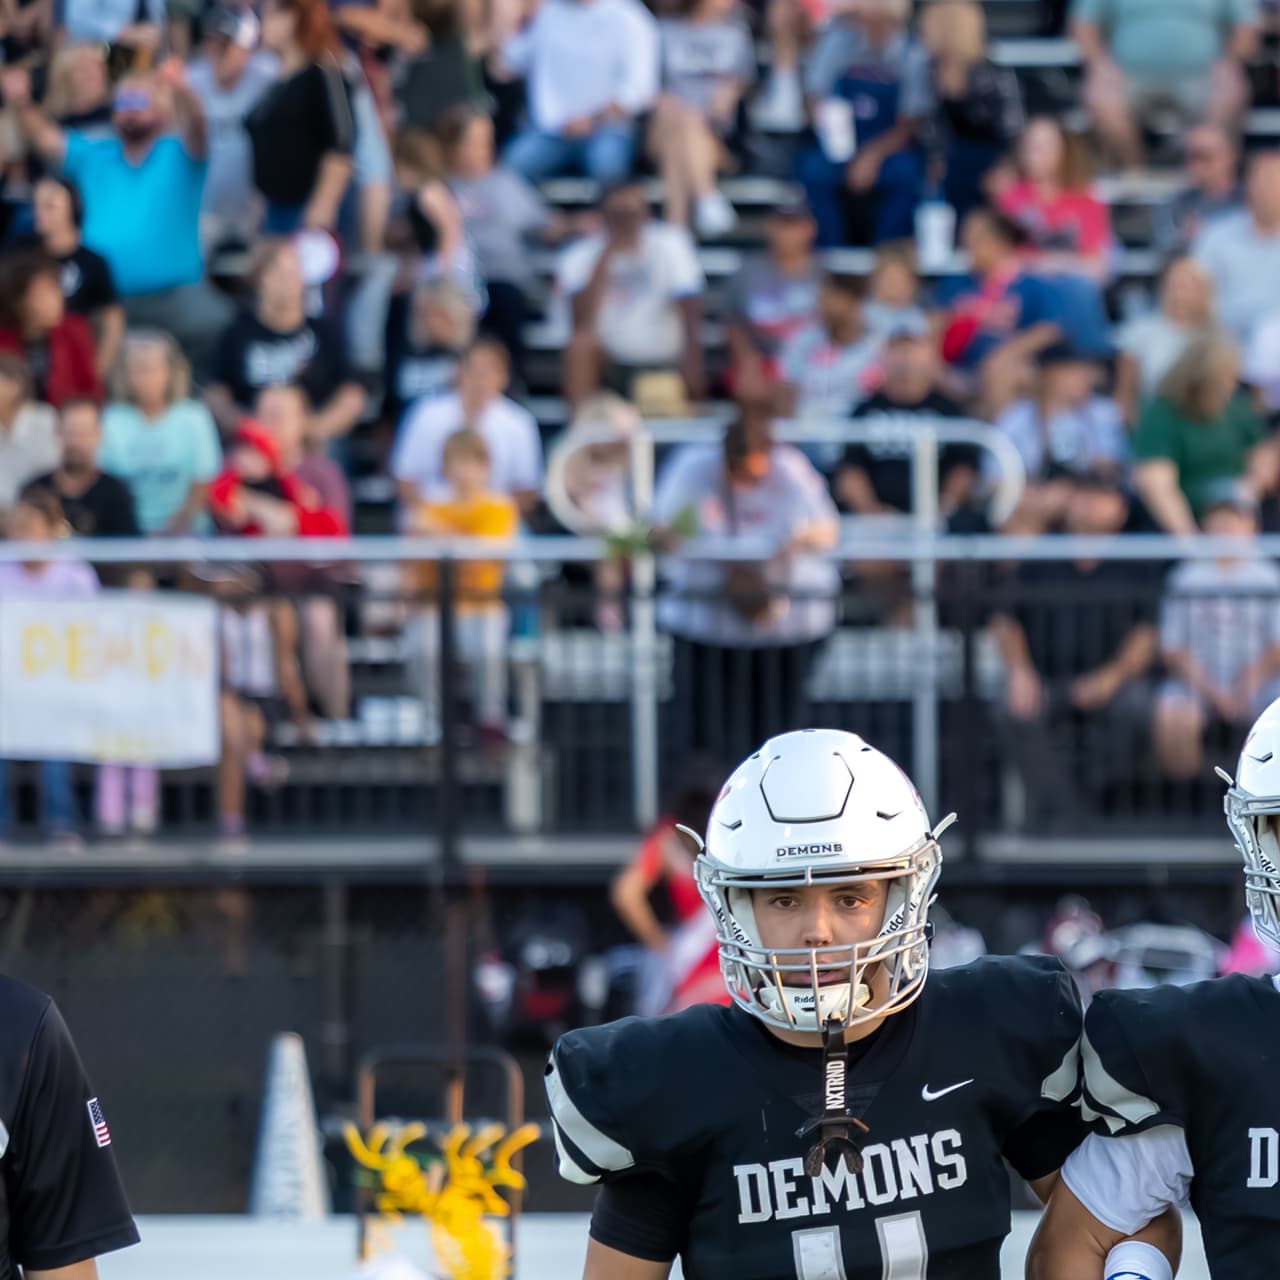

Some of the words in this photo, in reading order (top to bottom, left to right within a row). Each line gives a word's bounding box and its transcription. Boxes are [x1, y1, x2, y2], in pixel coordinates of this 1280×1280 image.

[776, 843, 843, 857] DEMONS
[825, 1059, 845, 1111] NXTRND
[733, 1128, 968, 1224] DEMONS
